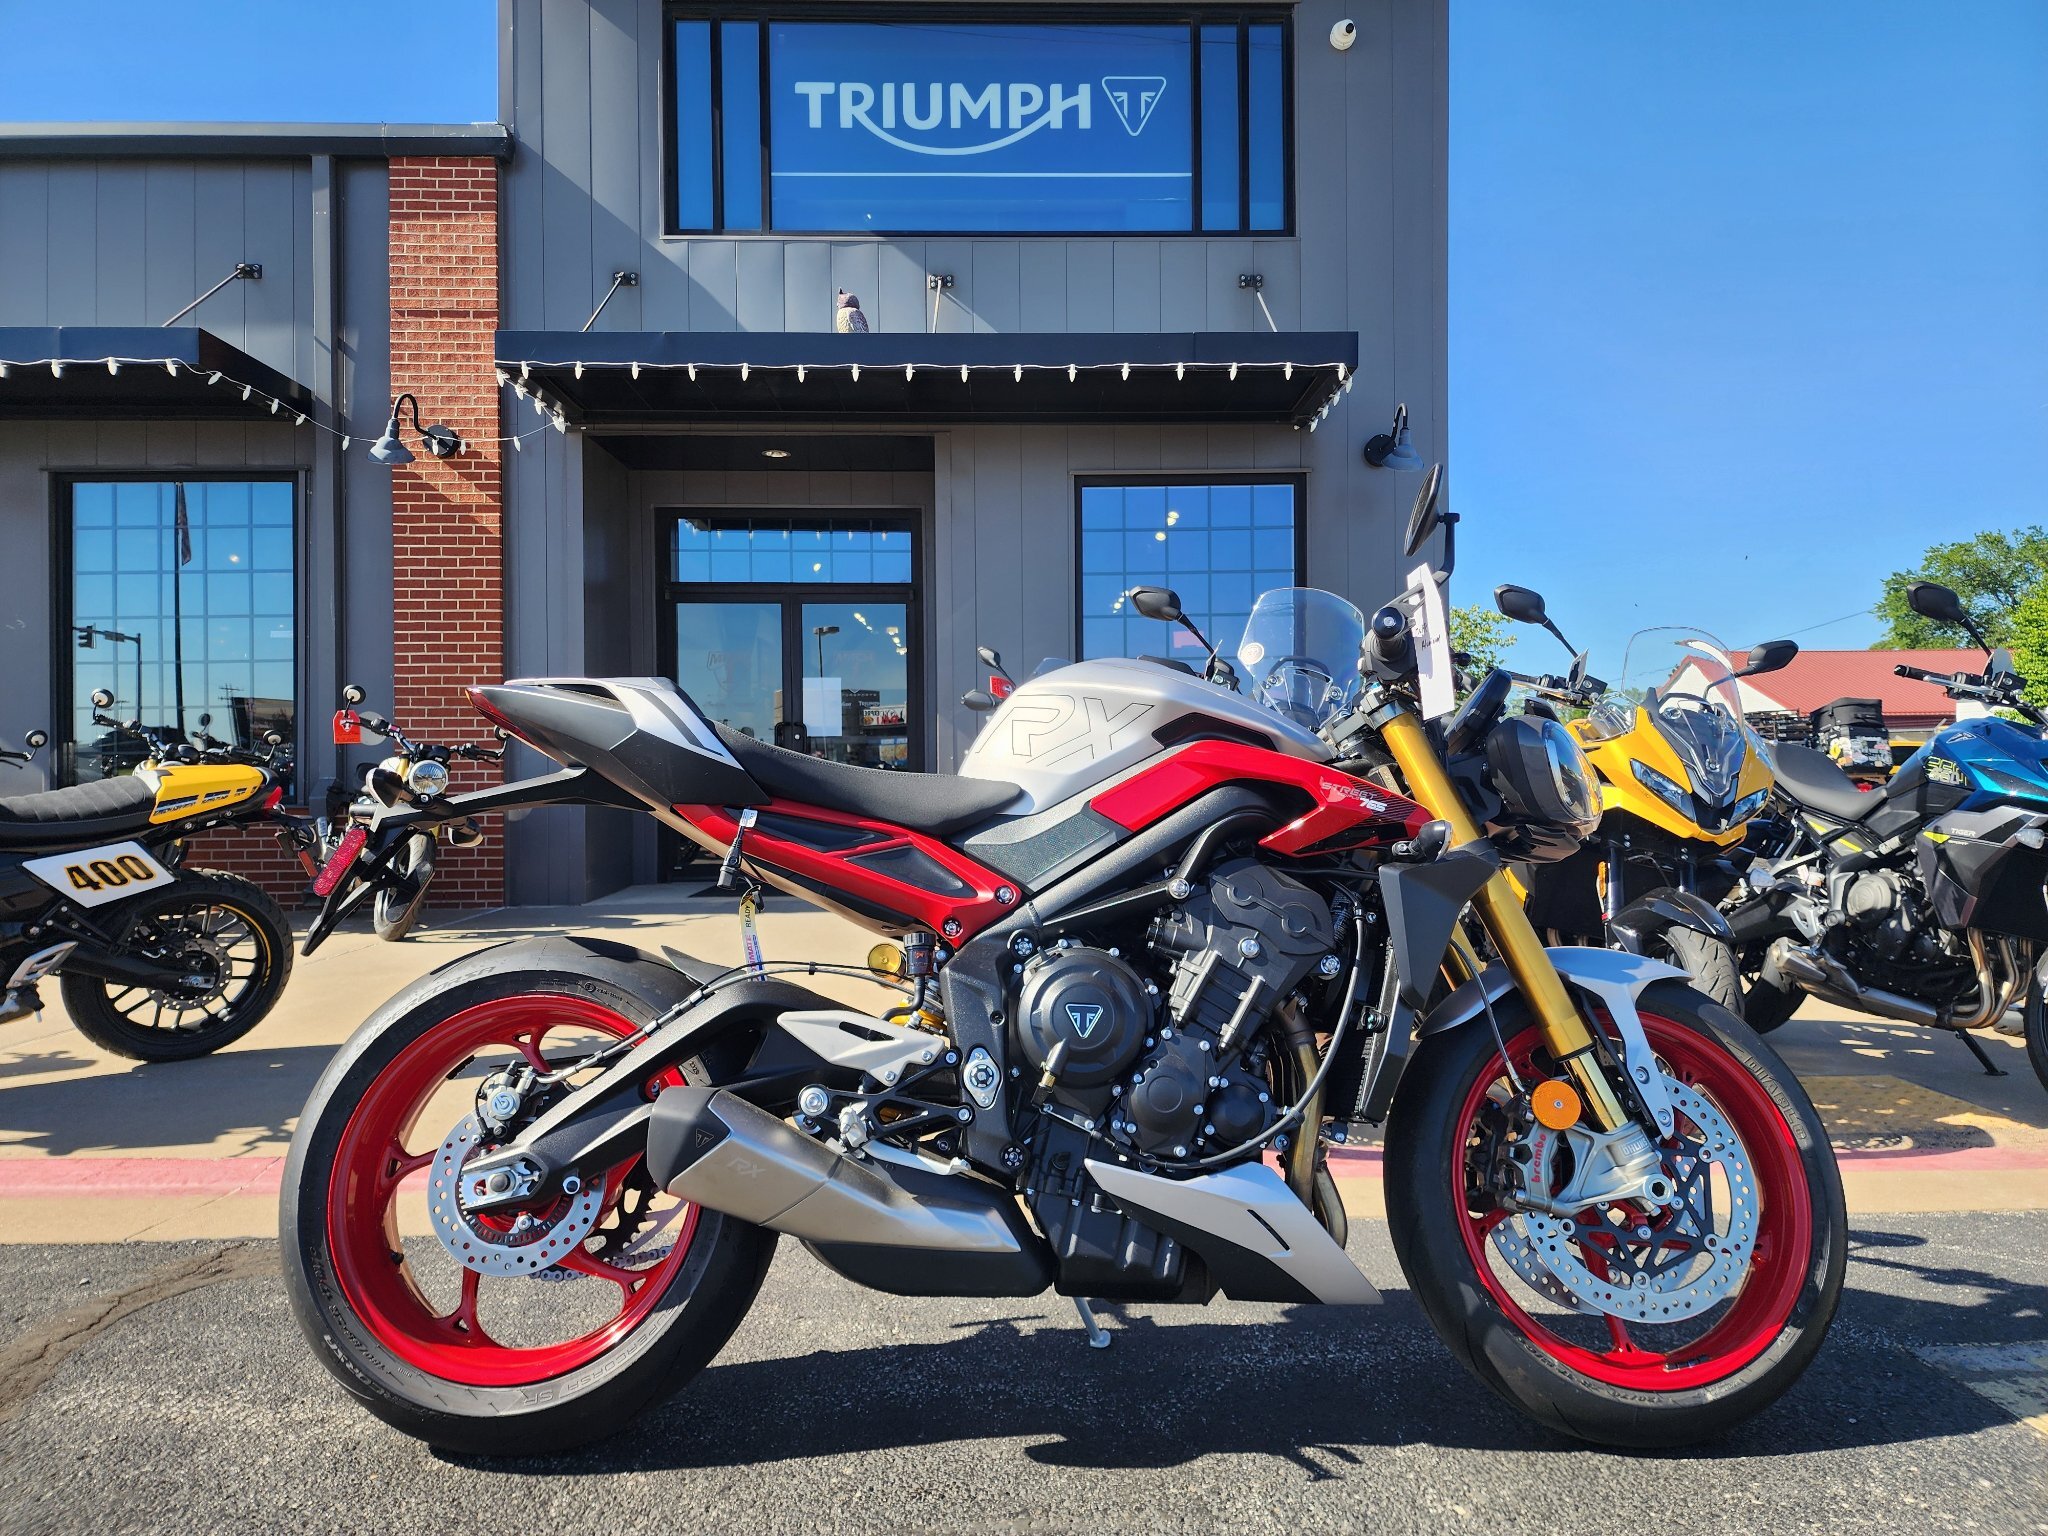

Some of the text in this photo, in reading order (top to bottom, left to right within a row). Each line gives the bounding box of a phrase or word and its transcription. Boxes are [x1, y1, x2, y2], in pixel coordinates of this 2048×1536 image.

[795, 82, 1091, 155] TRIUMPH
[1321, 782, 1378, 799] STREET
[1360, 797, 1388, 812] 765
[1951, 827, 1976, 838] TIGER
[64, 855, 157, 891] 400
[744, 904, 752, 928] READY
[1531, 1133, 1547, 1183] brembo
